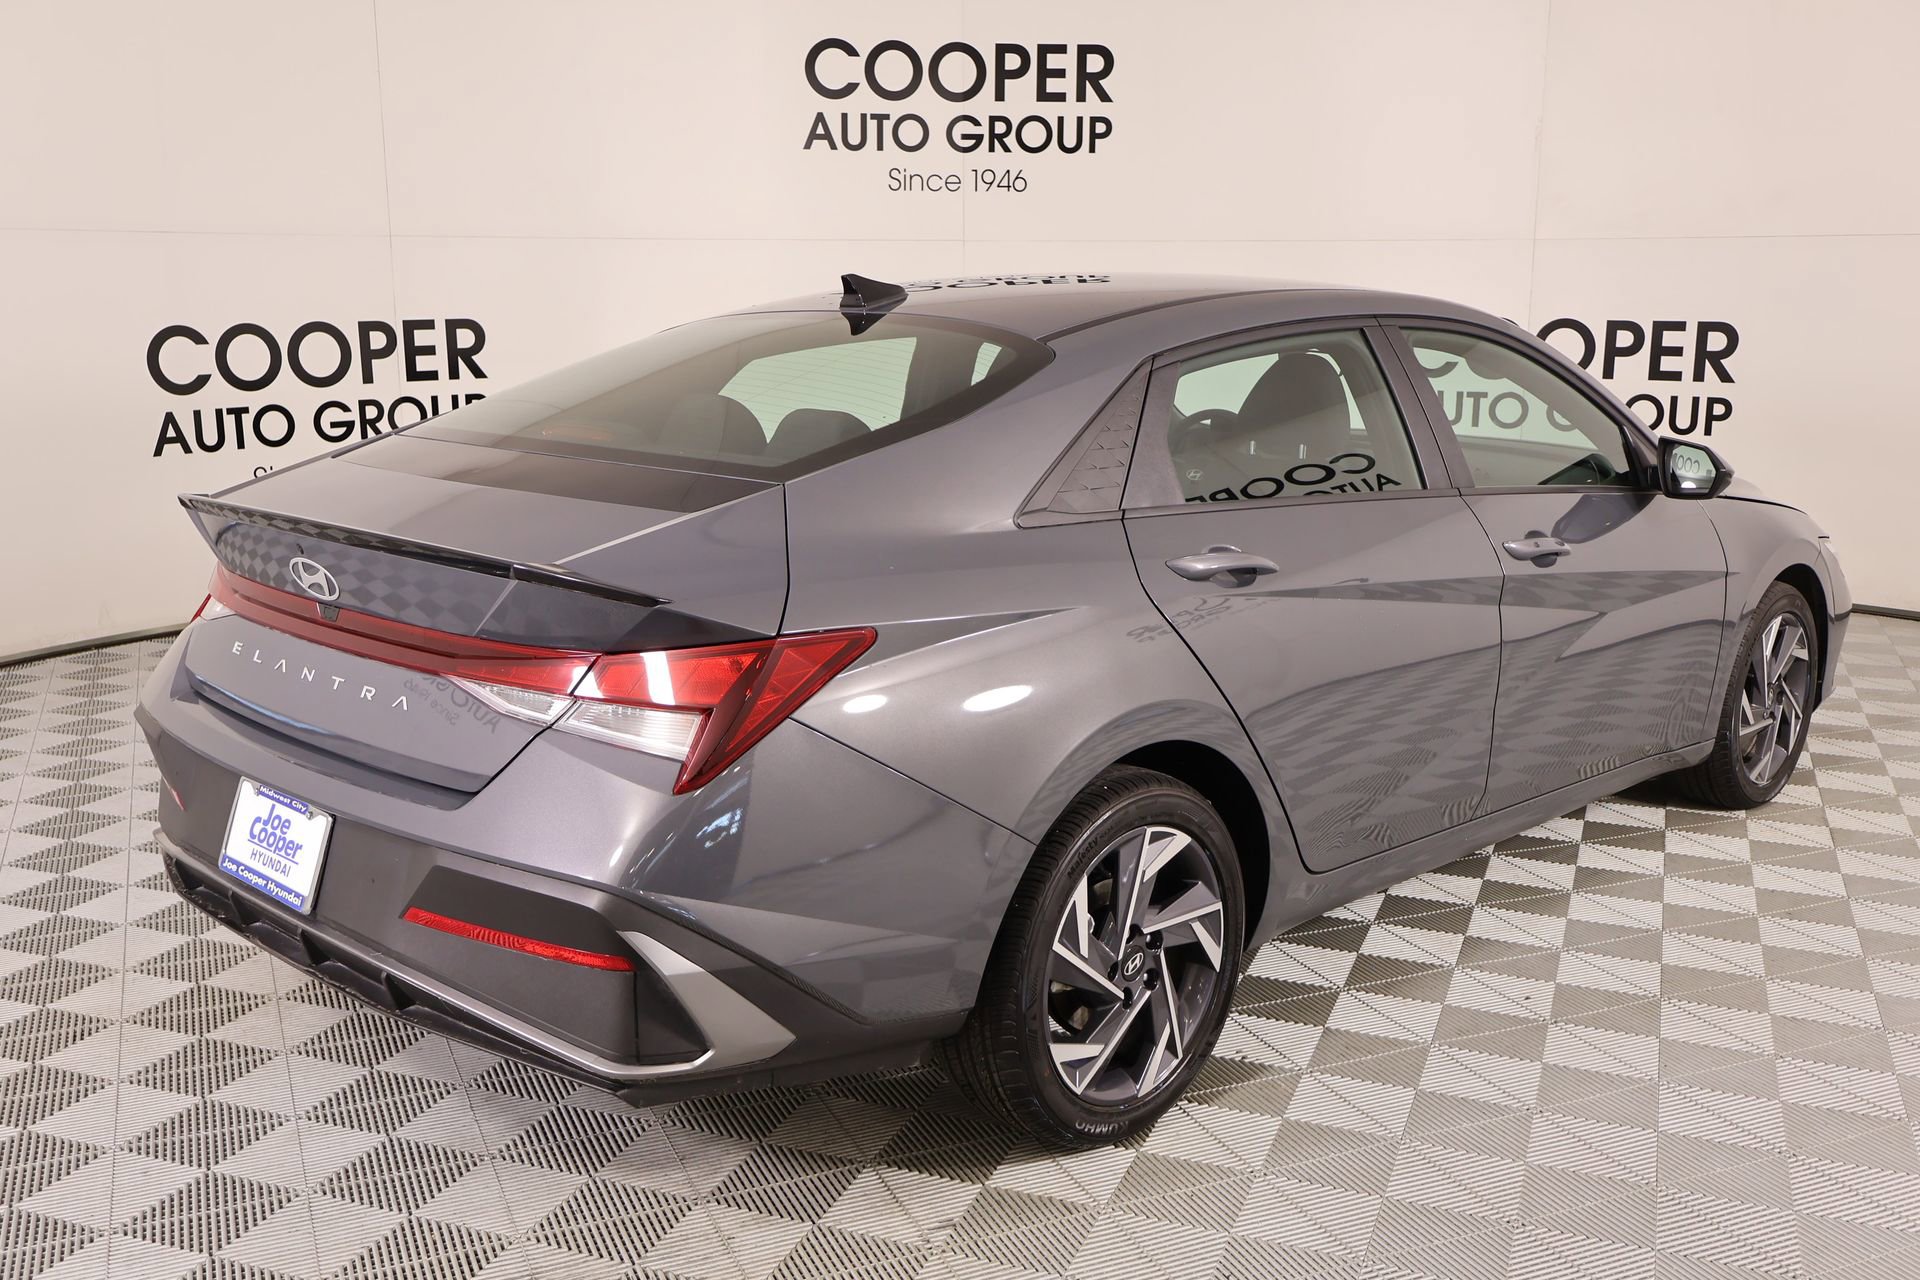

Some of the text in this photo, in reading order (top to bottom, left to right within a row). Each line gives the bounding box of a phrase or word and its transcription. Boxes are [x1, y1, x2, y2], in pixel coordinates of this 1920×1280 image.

[804, 37, 1115, 103] COOPER
[802, 112, 1113, 154] AUTO GROUP
[888, 167, 1028, 192] Since 1946
[146, 318, 489, 396] COOPER
[1423, 317, 1740, 384] OPER
[153, 404, 296, 457] AUTO
[1437, 390, 1530, 430] UTO
[231, 641, 409, 711] ELANTRA
[259, 785, 307, 813] Midwest City
[262, 803, 292, 836] Joe
[249, 815, 304, 860] Cooper
[222, 858, 303, 907] Joe Cooper Hyundai
[250, 847, 292, 878] HYUNDAI
[1075, 1118, 1129, 1135] KUMHO
